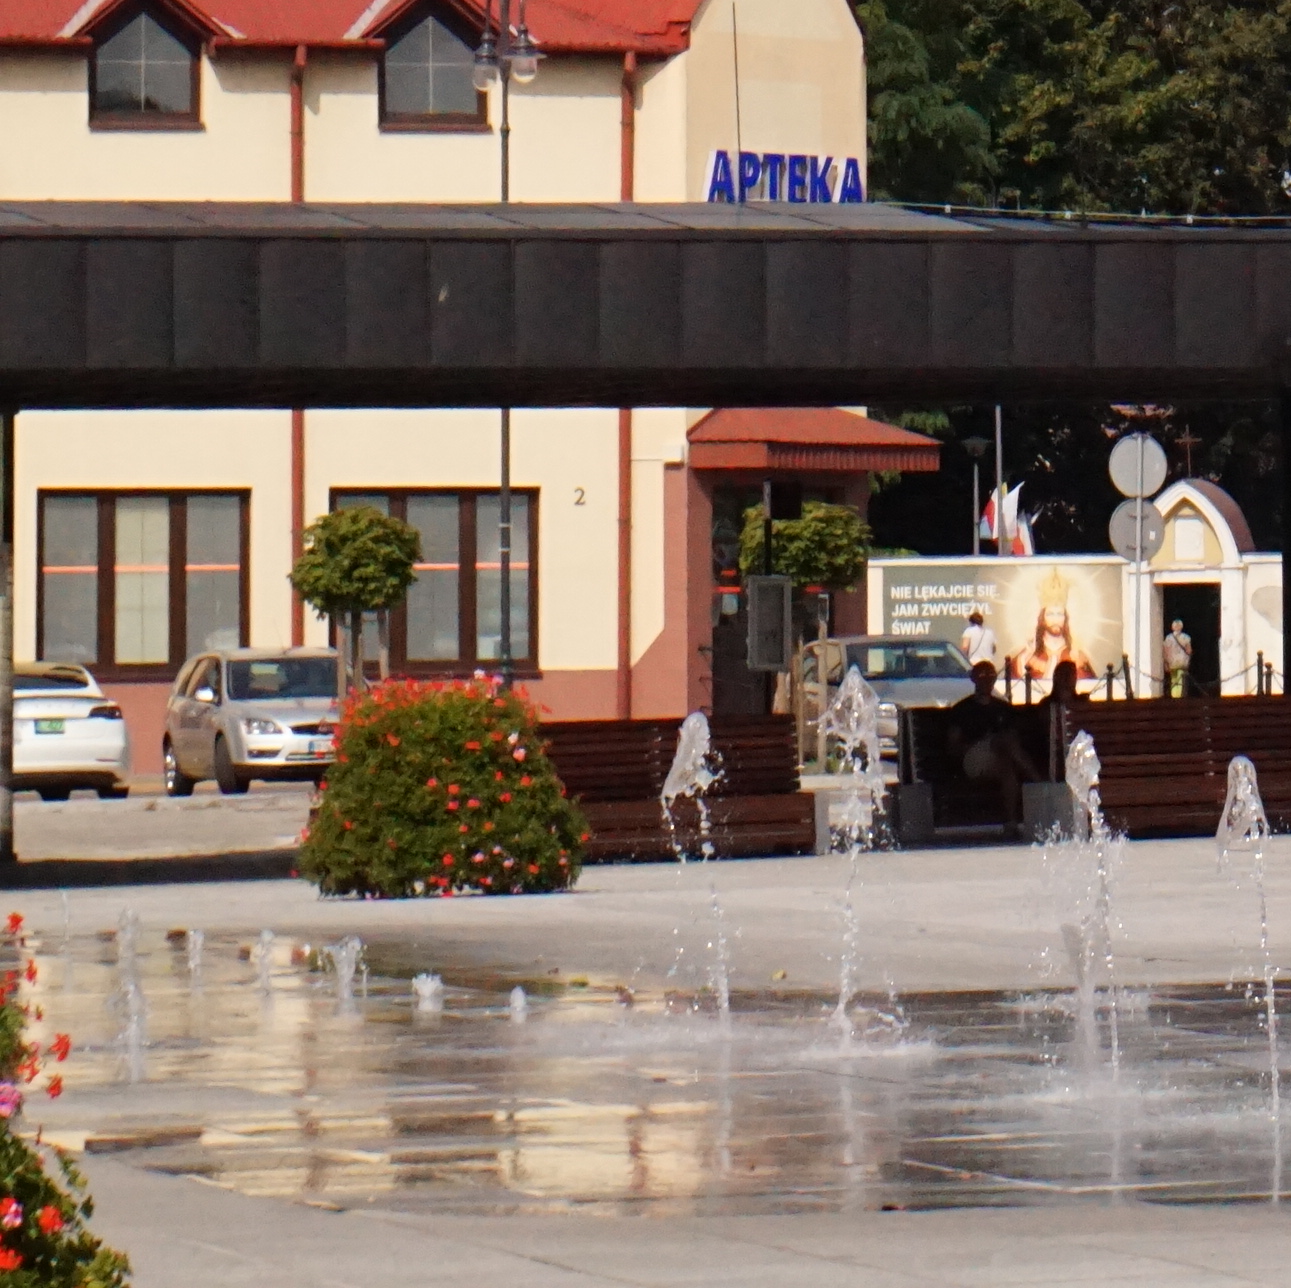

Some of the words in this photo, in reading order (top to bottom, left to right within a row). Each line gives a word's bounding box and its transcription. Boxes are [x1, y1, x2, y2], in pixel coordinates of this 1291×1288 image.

[707, 150, 863, 203] APTEKA
[574, 486, 586, 506] 2
[890, 586, 912, 600] NIE
[914, 585, 974, 601] LĘKAJCIE
[891, 603, 919, 618] JAM
[891, 619, 931, 636] ŚWIAT
